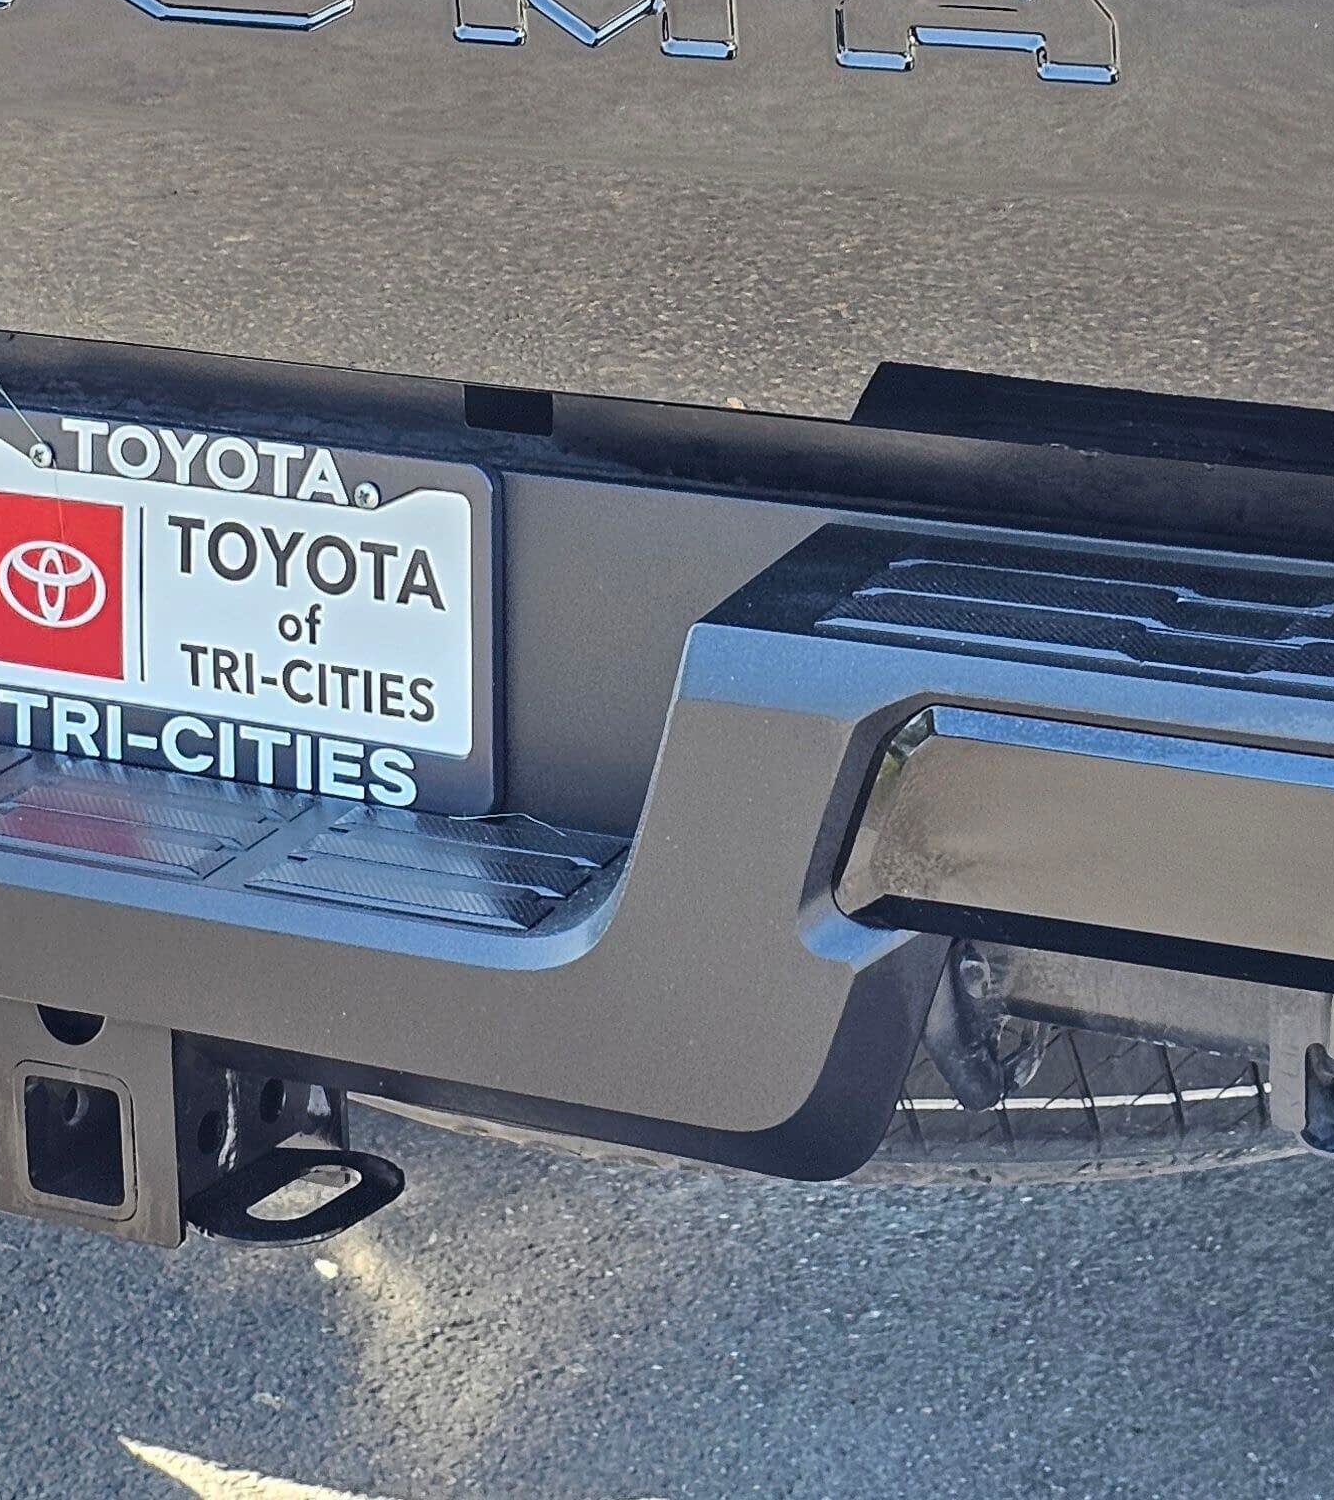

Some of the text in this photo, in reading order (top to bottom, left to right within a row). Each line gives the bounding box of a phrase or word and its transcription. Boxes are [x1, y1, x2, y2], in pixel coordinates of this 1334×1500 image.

[61, 416, 350, 507] TOYOTA
[167, 514, 447, 612] TOYOTA
[277, 602, 322, 645] of
[180, 642, 436, 723] TRI-CITIES
